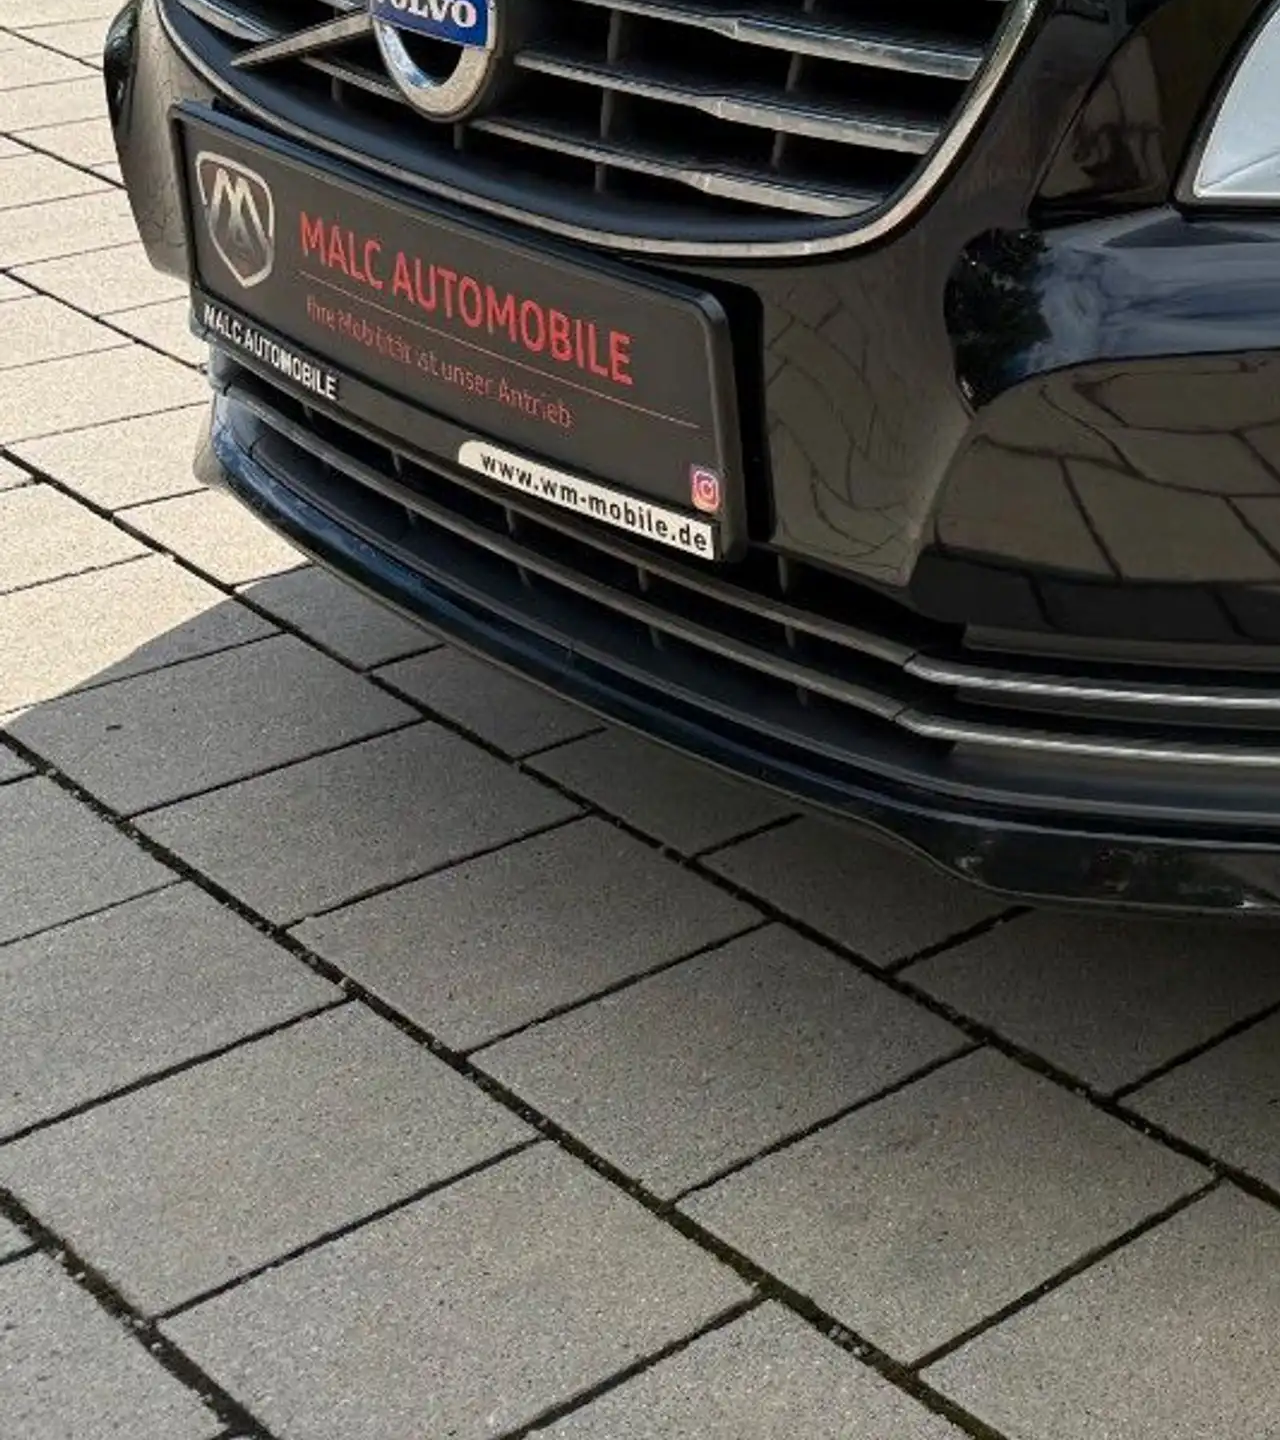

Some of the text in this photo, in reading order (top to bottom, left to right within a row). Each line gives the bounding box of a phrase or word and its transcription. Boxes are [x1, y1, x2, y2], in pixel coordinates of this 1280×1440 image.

[300, 210, 634, 386] MALC AUTOMOBILE
[203, 303, 337, 401] MALC AUTOMOBILE
[441, 361, 492, 395] unser
[480, 451, 708, 552] www.wm-mobile.de
